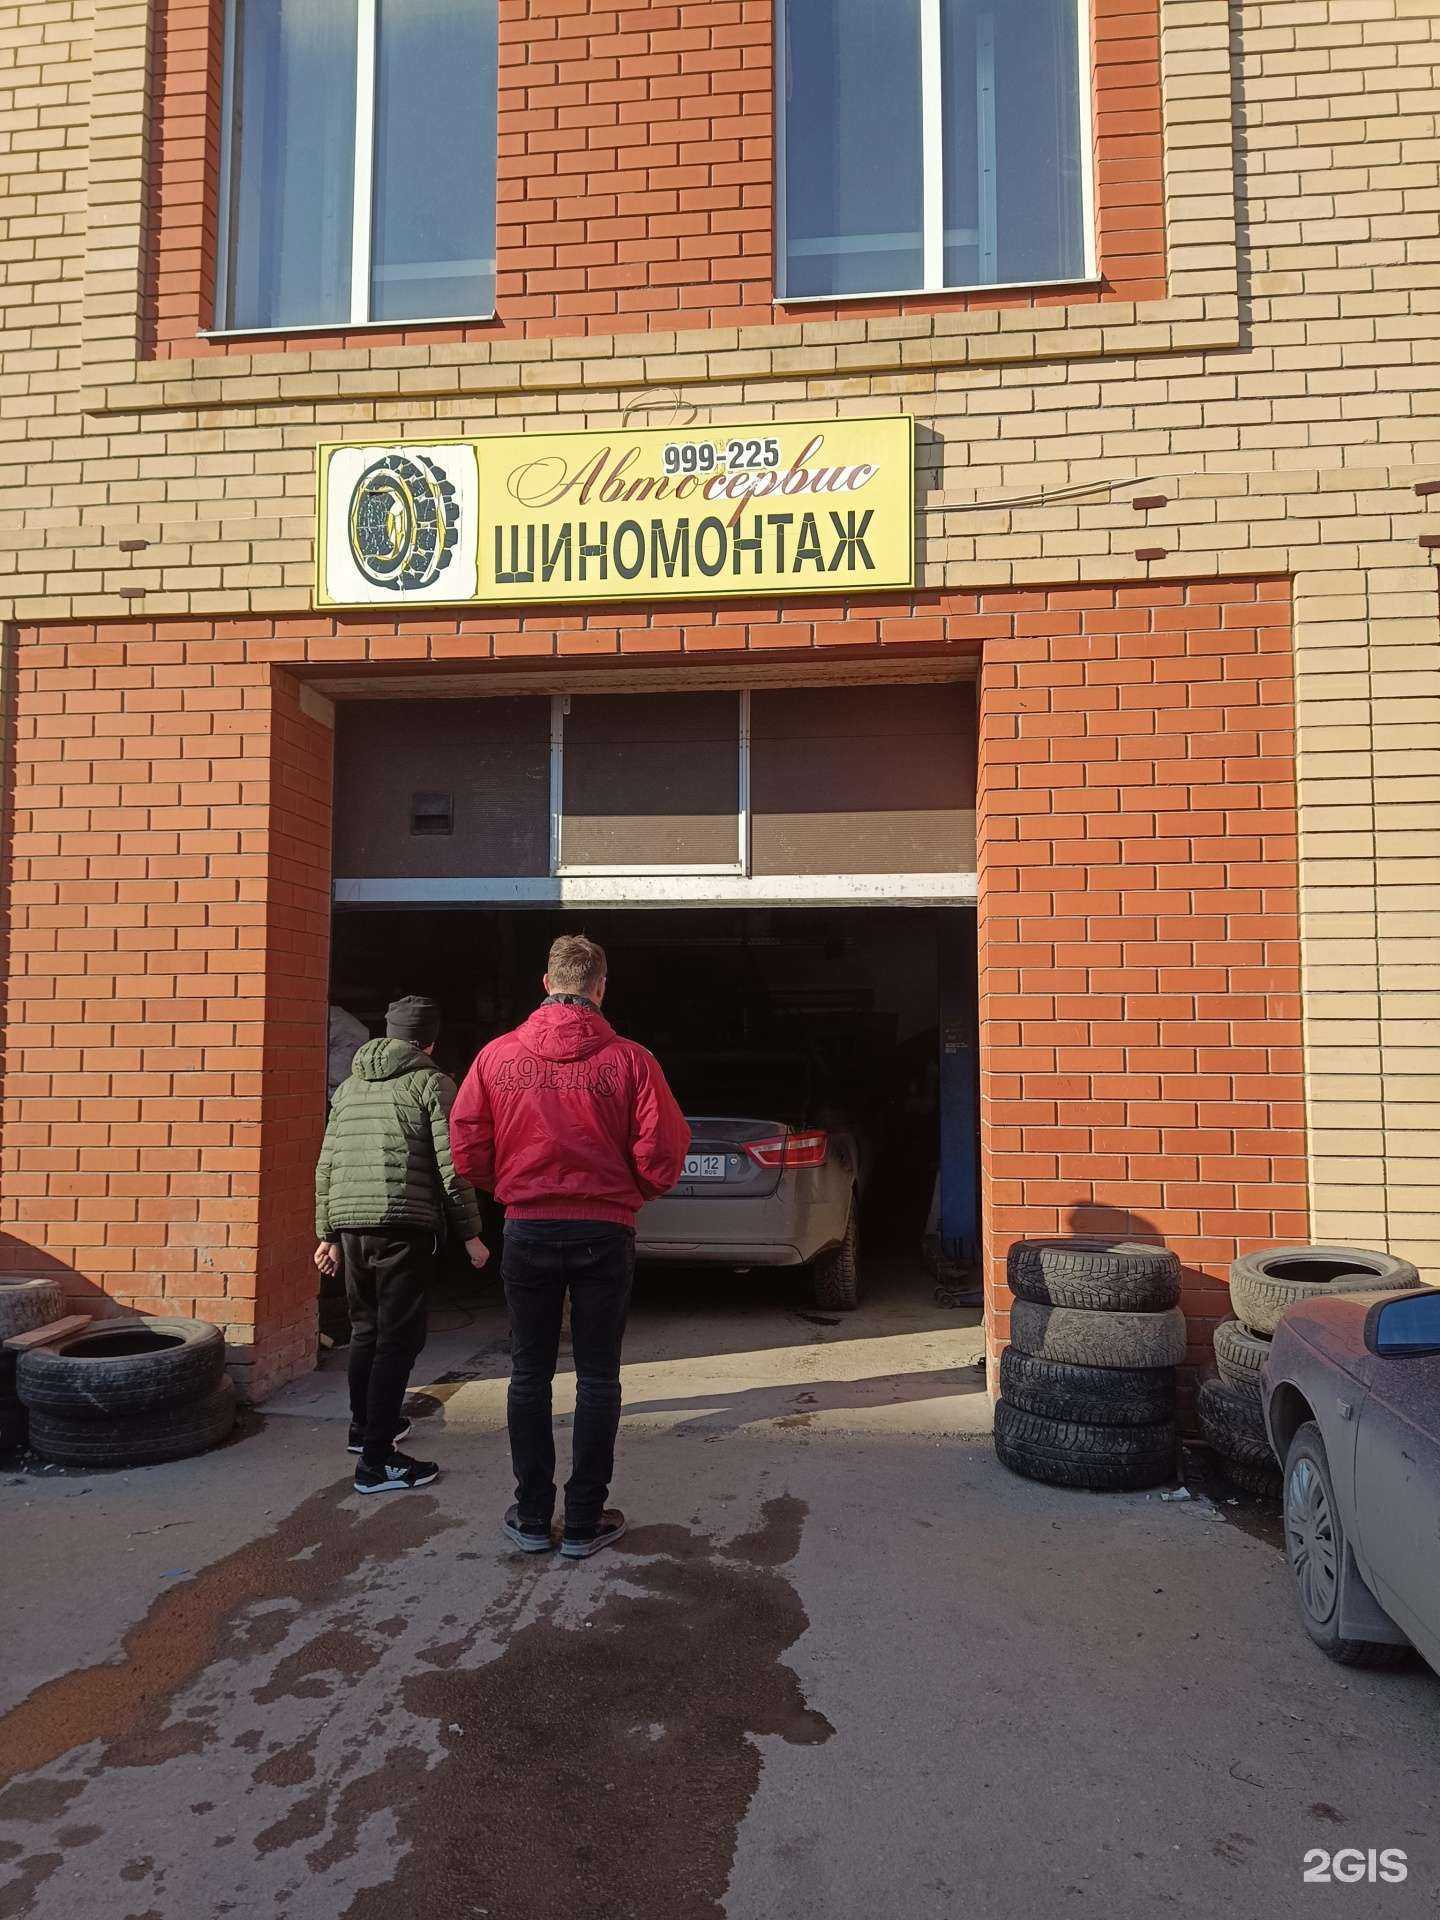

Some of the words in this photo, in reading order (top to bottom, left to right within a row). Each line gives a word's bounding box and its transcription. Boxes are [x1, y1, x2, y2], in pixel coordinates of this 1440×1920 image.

[664, 439, 779, 474] 999-225
[507, 434, 878, 528] Автосервис
[494, 510, 875, 584] ШИНОМОНТАЖ
[495, 1056, 618, 1097] 49ERS
[703, 1156, 719, 1169] 12
